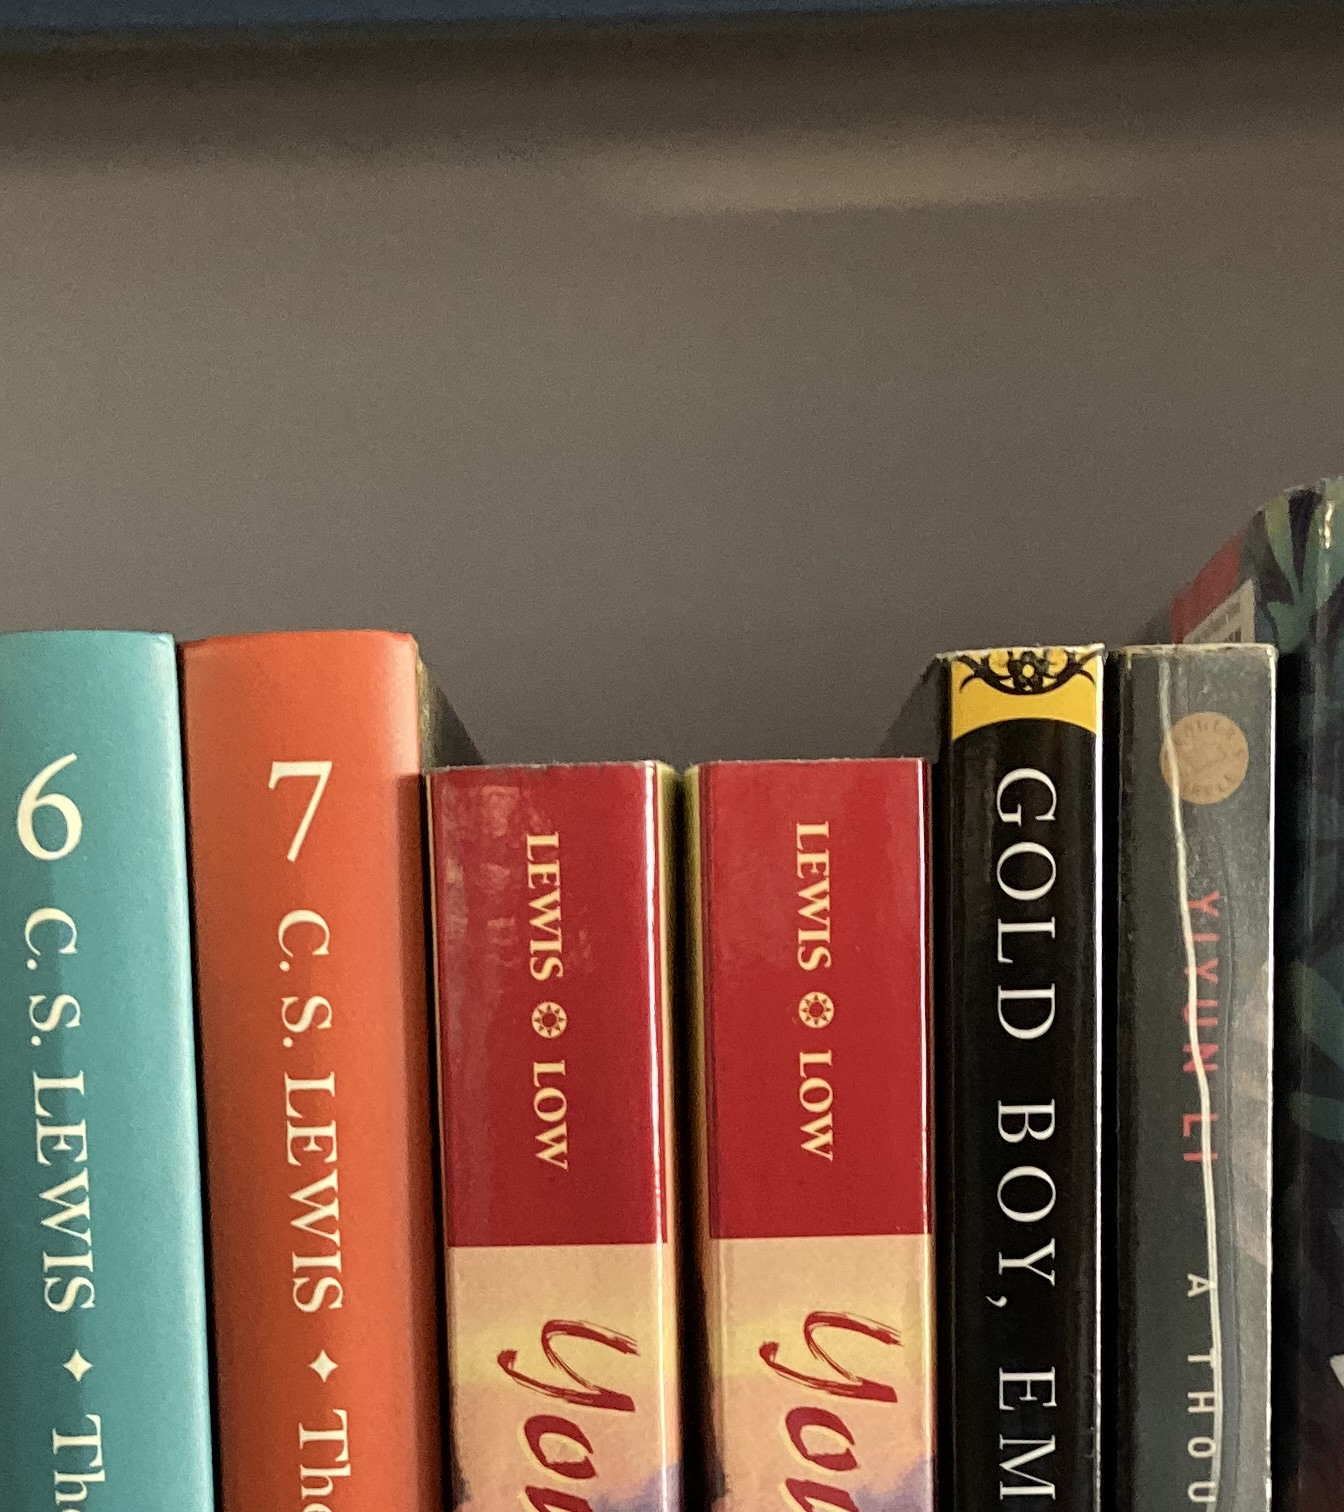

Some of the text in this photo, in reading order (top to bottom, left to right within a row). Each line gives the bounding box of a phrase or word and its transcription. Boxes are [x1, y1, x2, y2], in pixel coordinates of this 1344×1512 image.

[16, 753, 82, 860] 6
[268, 760, 334, 862] 7
[996, 767, 1056, 1041] GOLD
[526, 831, 569, 1171] LEWIS LOW
[796, 821, 834, 1161] LEWIS LOW
[32, 1070, 96, 1313] LEWIS
[277, 909, 344, 1313] C. S. LEWIS
[986, 1099, 1057, 1308] BOY,
[1183, 1112, 1218, 1161] LI
[1187, 1273, 1216, 1297] A
